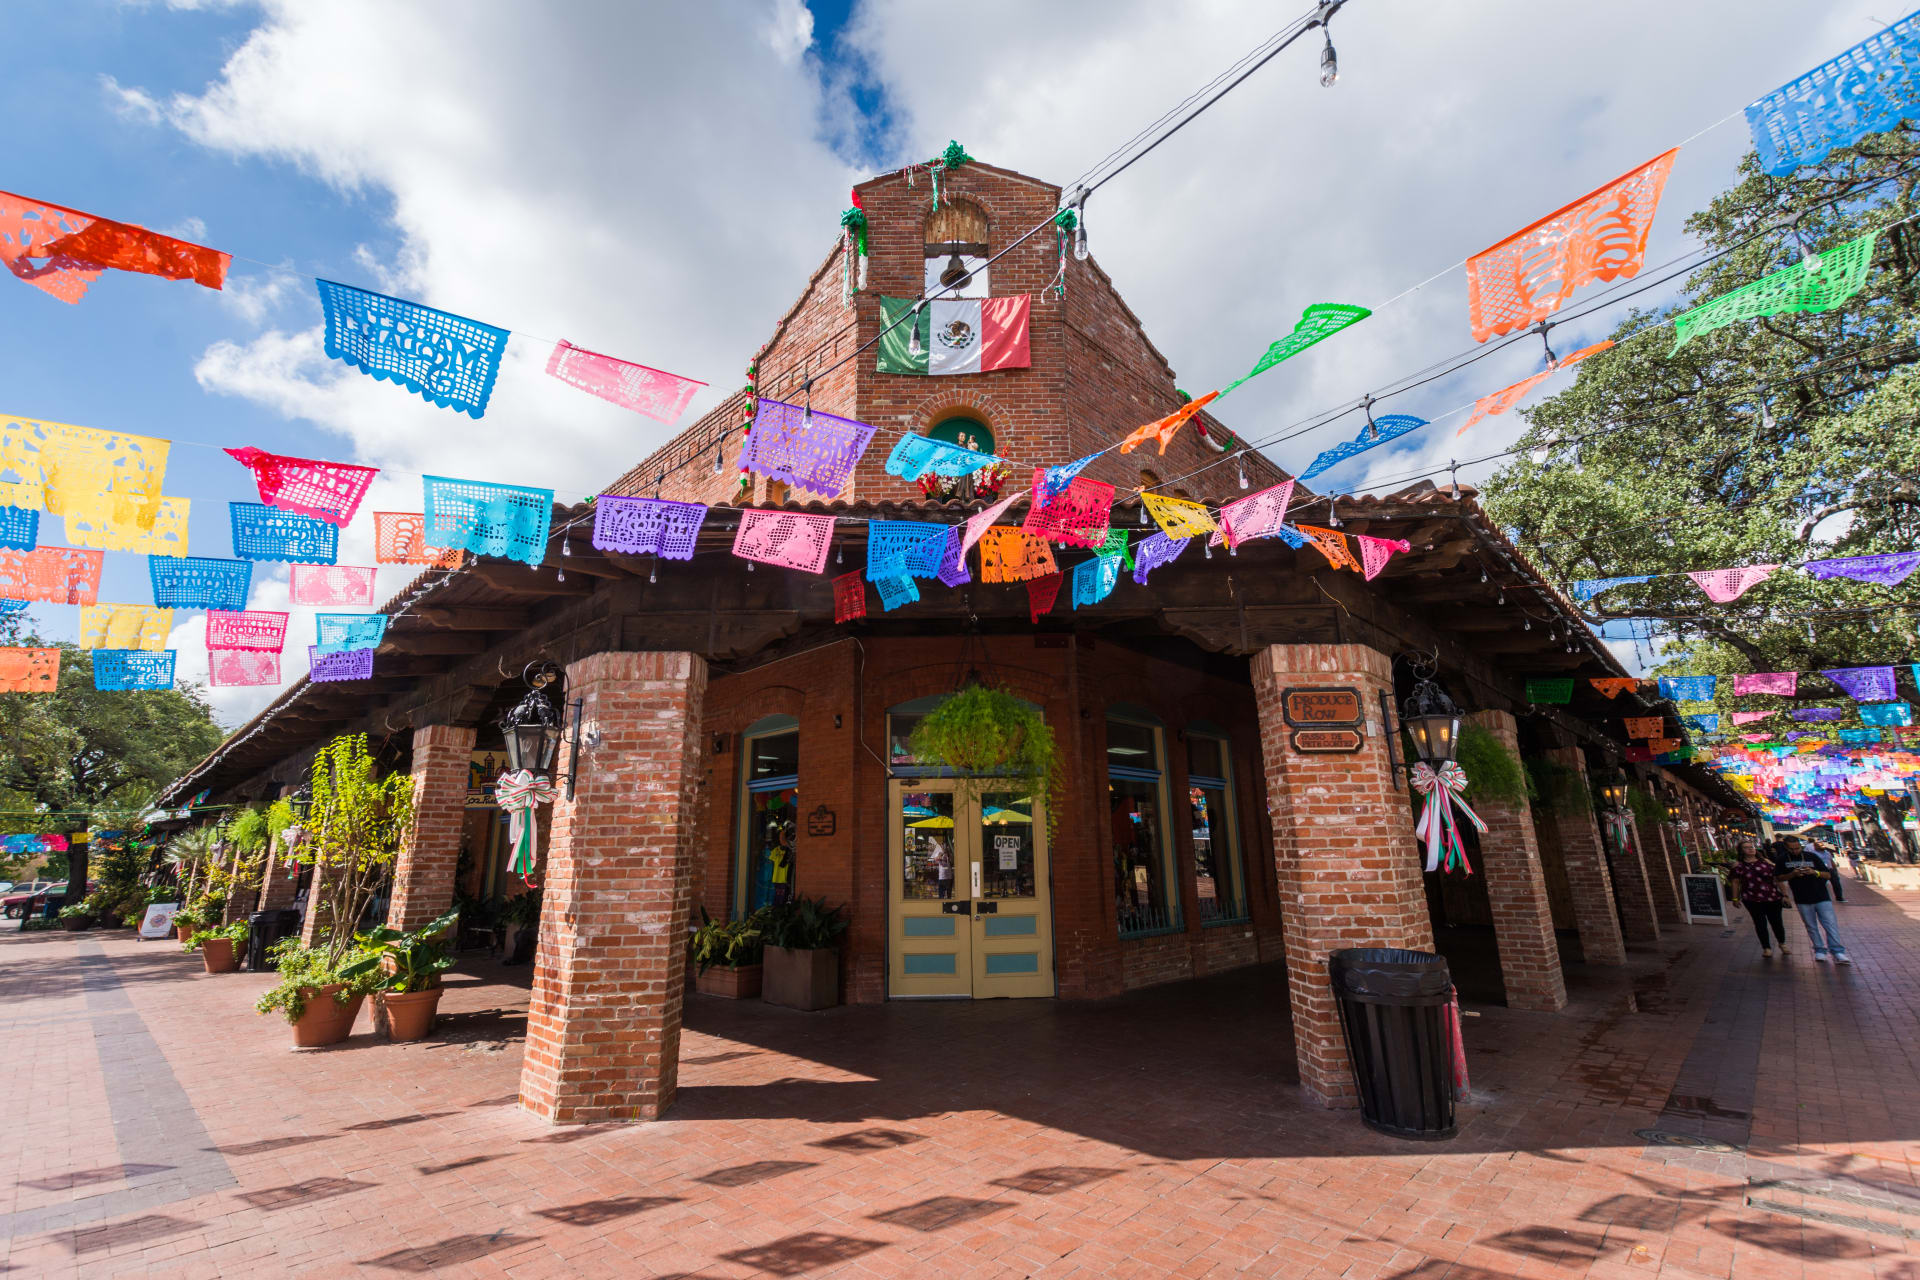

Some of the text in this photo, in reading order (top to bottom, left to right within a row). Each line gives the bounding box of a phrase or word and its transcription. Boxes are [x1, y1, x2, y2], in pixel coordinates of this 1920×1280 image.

[608, 509, 680, 529] MARKET
[216, 618, 271, 631] MARKET
[222, 625, 278, 644] SQUARE
[1293, 695, 1353, 711] PRODUCE
[996, 837, 1020, 849] OPEN
